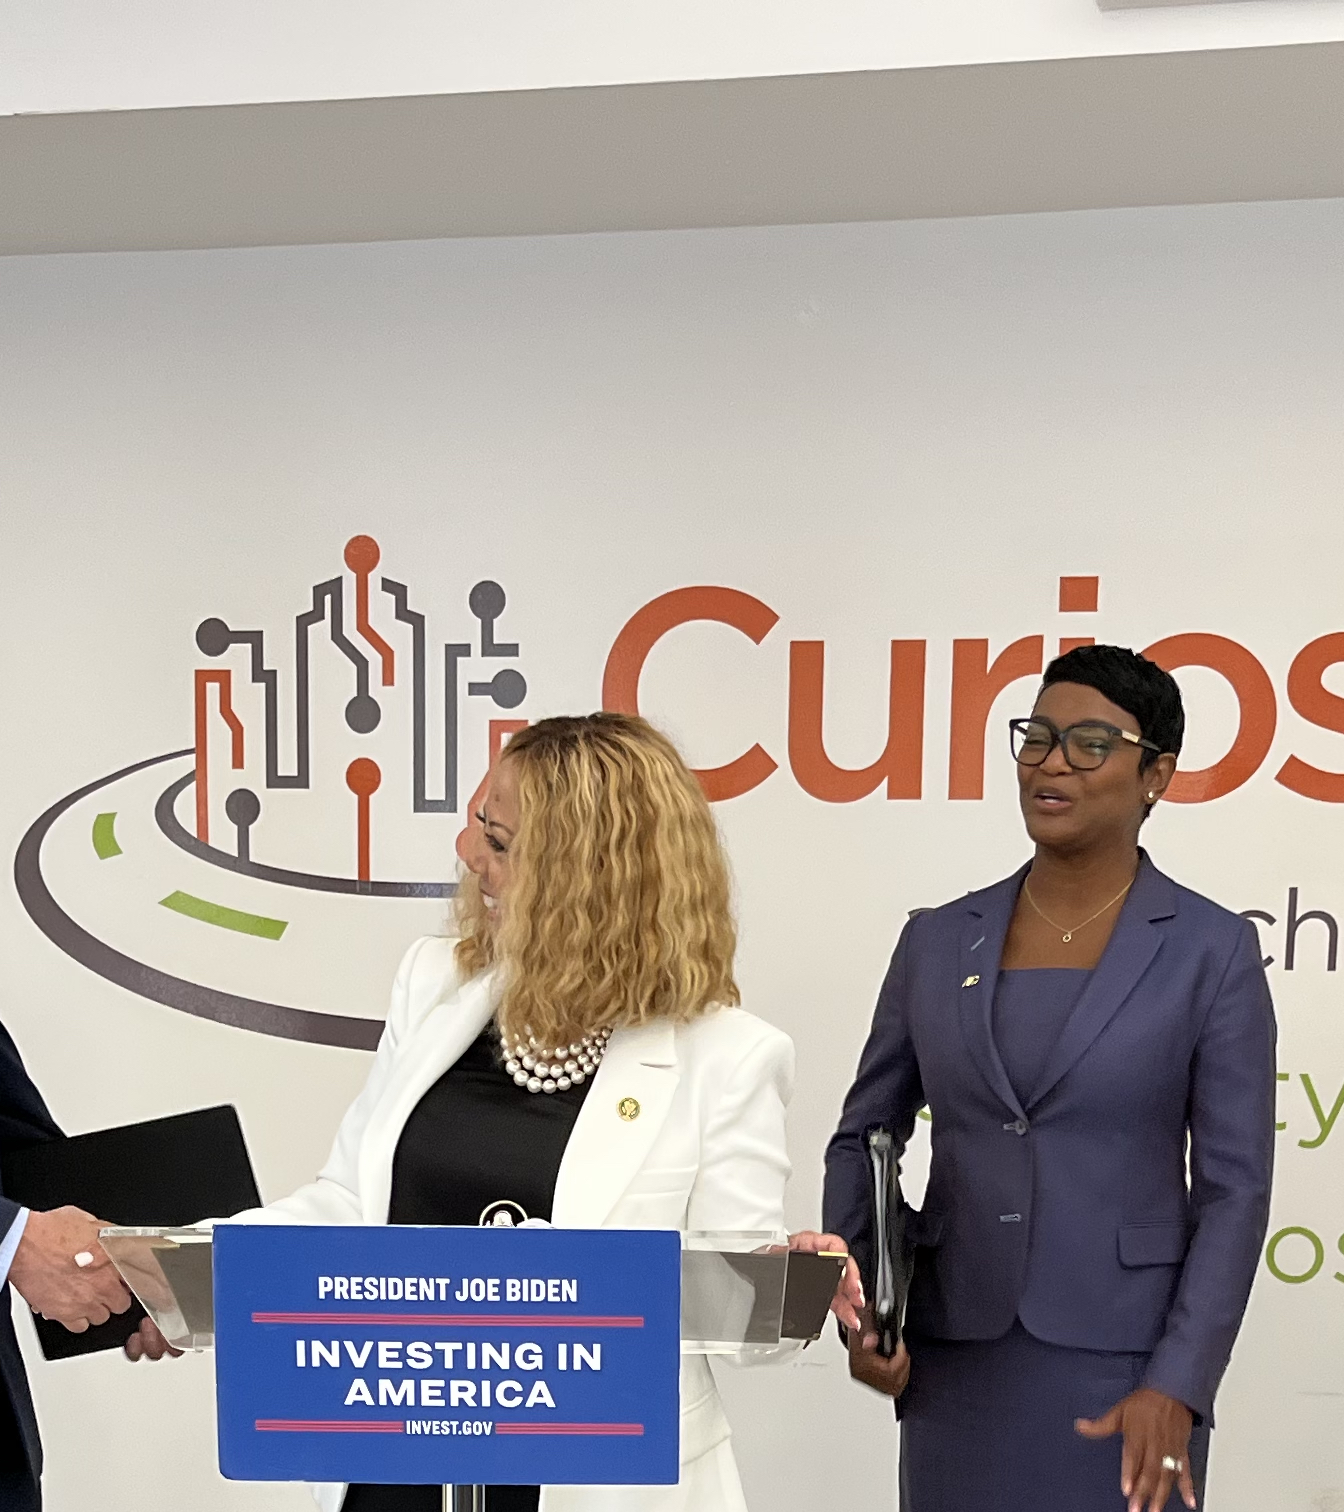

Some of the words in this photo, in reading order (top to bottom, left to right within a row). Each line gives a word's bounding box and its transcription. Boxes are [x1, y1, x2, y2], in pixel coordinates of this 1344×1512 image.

[318, 1276, 451, 1301] PRESIDENT
[454, 1277, 502, 1302] JOE
[506, 1278, 578, 1302] BIDEN
[296, 1339, 544, 1371] INVESTING
[558, 1343, 602, 1371] IN
[343, 1378, 556, 1408] AMERICA
[405, 1420, 493, 1436] INVEST.GOV
